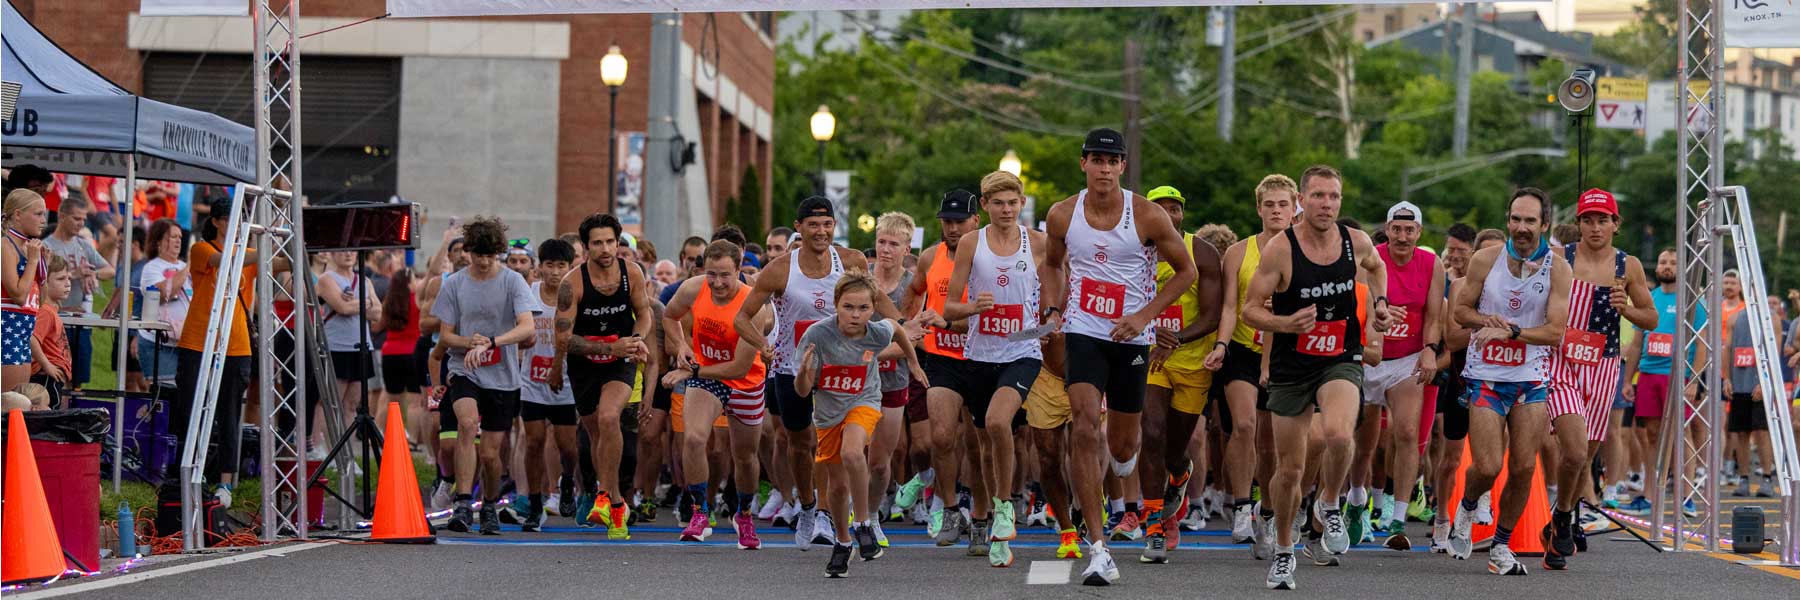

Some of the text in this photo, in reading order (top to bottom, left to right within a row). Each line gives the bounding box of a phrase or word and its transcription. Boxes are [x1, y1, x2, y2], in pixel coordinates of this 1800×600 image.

[1743, 12, 1782, 22] KNOX.TN
[162, 120, 207, 158] KNOXVILLE
[208, 132, 232, 166] TRACK
[231, 140, 249, 172] CLUB
[1086, 293, 1116, 315] 780
[982, 316, 1020, 334] 1390
[701, 343, 731, 361] 1043
[1305, 335, 1337, 352] 749
[1565, 342, 1601, 363] 1851
[1647, 342, 1671, 354] 1998
[1485, 344, 1523, 363] 1204
[1736, 354, 1753, 365] 712
[822, 375, 862, 391] 1184
